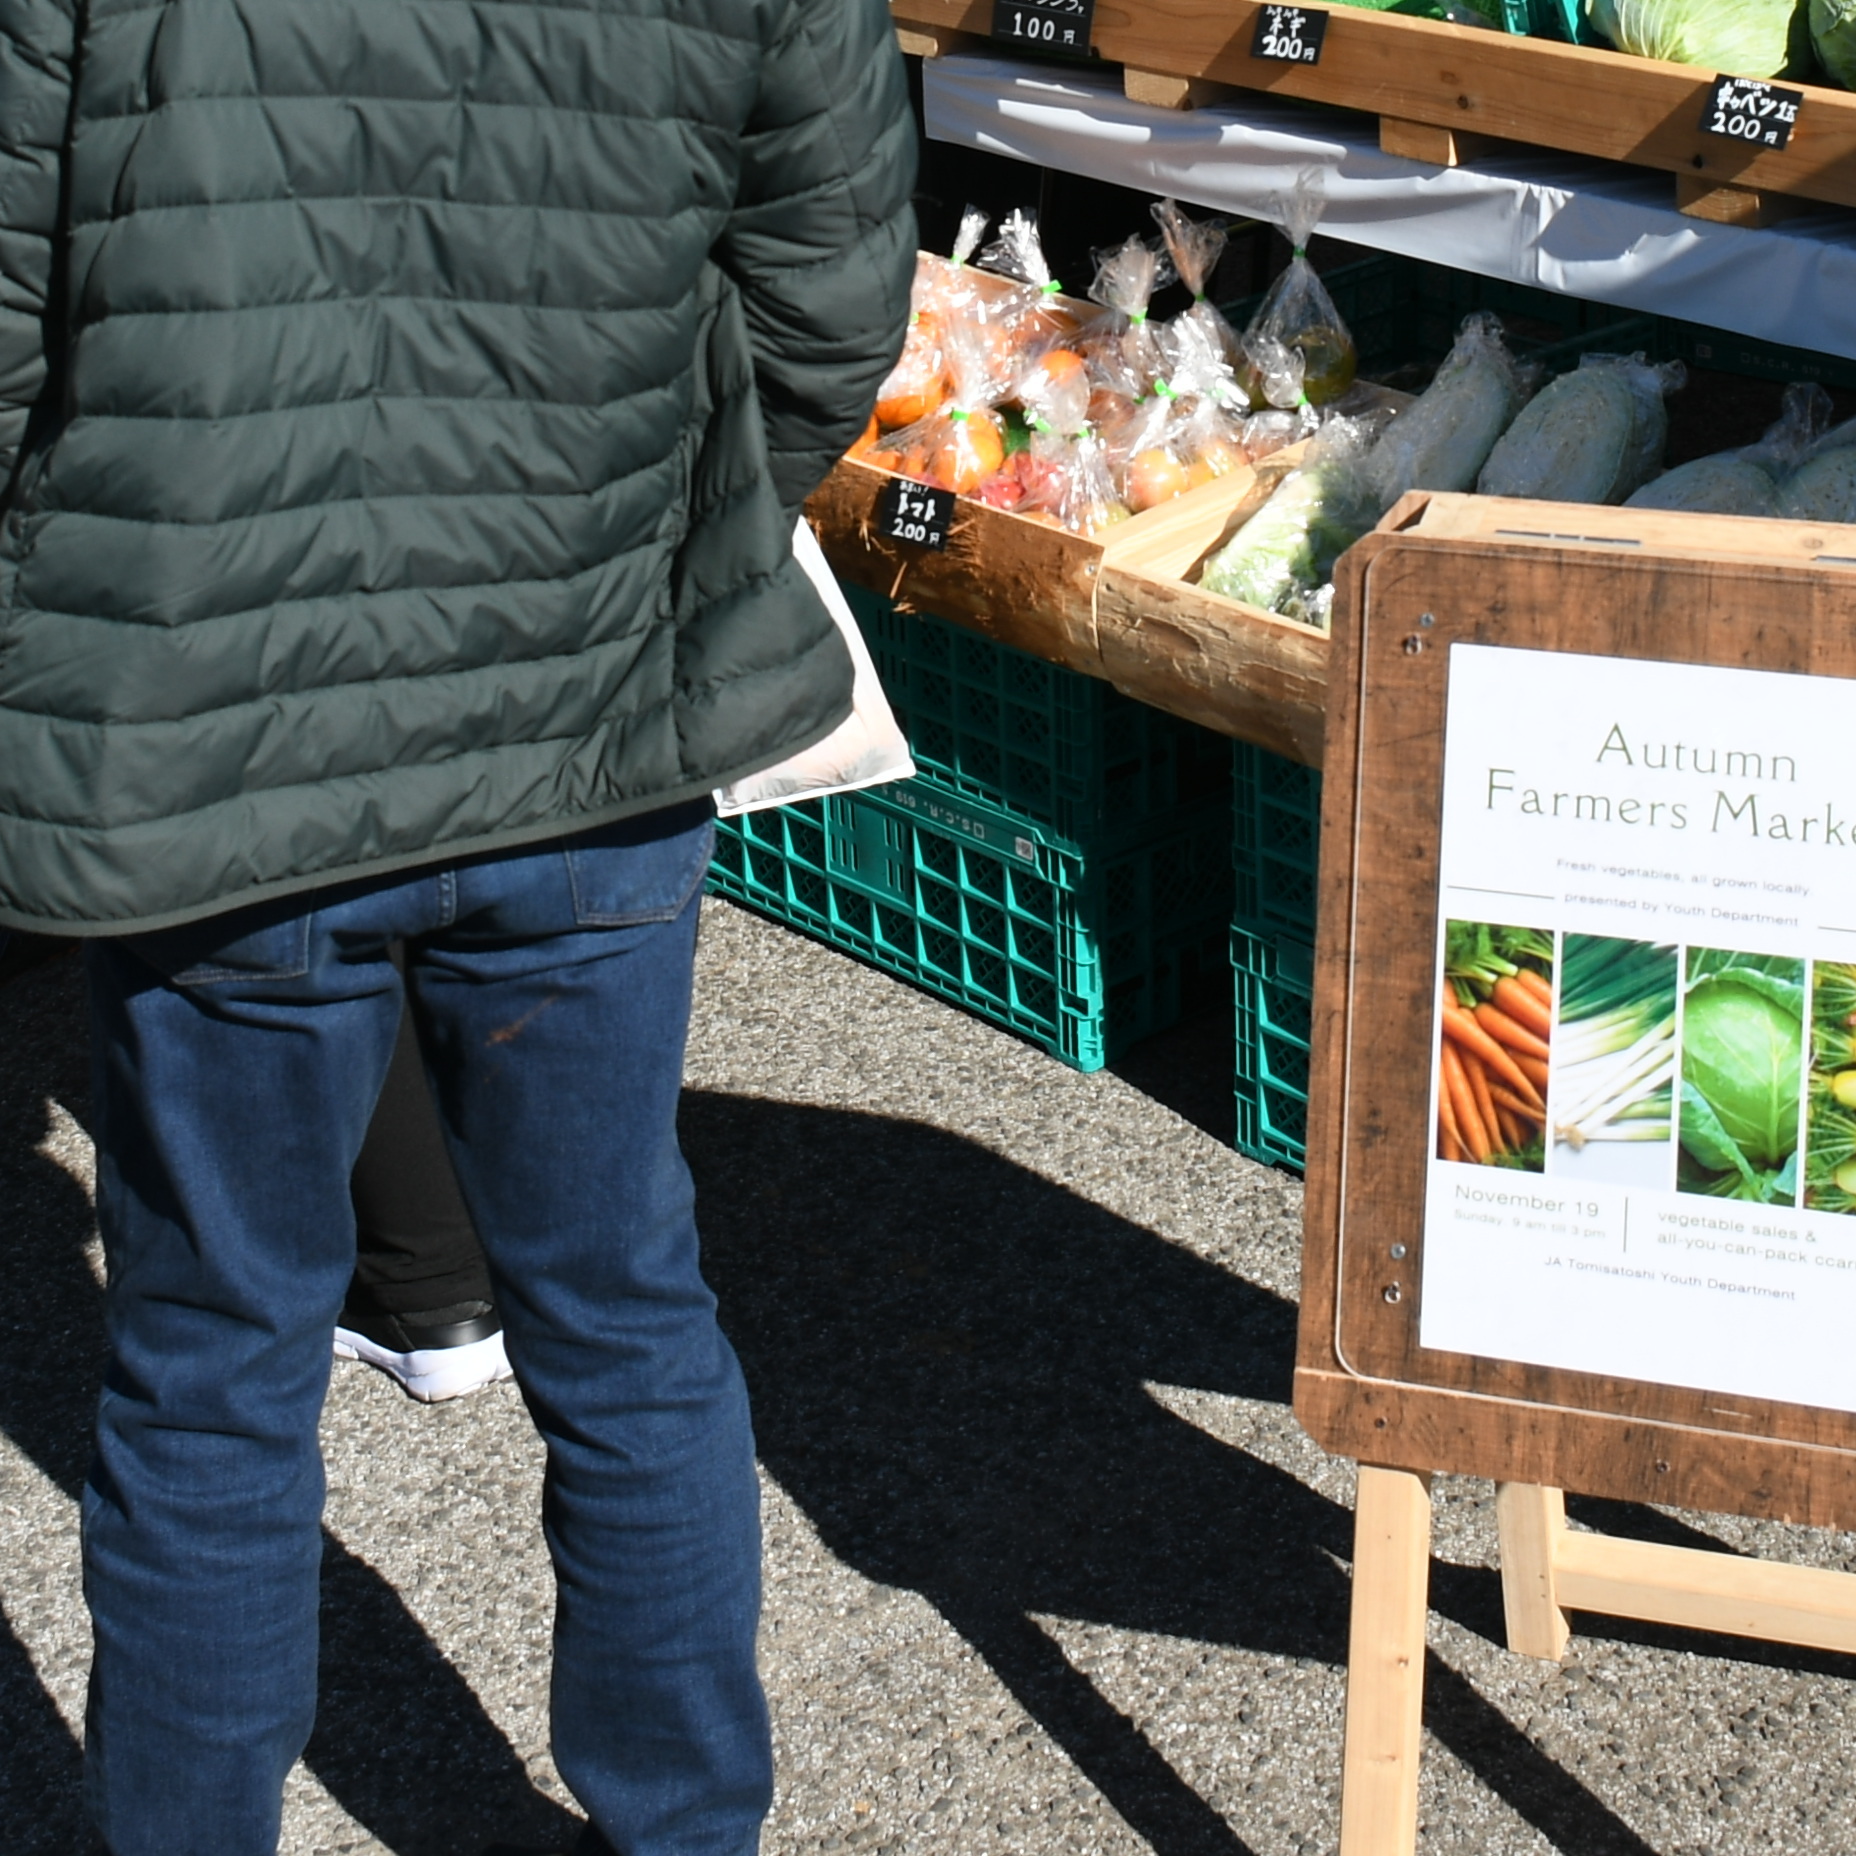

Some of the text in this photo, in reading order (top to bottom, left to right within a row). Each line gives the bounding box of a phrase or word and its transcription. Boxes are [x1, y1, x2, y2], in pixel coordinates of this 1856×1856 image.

[1012, 11, 1076, 45] 100円
[1269, 16, 1306, 38] ネギ
[1261, 34, 1316, 62] 200円
[1710, 111, 1778, 145] 200円
[896, 492, 936, 523] トマト
[891, 516, 941, 545] 200円
[1595, 722, 1797, 782] Autumn
[1485, 767, 1689, 830] Farmers
[1556, 858, 1597, 873] Fresh
[1601, 862, 1685, 884] vegetables,
[1690, 872, 1709, 885] all
[1712, 875, 1758, 892] grown
[1563, 891, 1800, 929] presented by Youth Department
[1454, 1183, 1600, 1218] November 19
[1512, 1216, 1521, 1227] 9
[1525, 1220, 1547, 1231] am
[1551, 1221, 1568, 1234] till
[1571, 1224, 1581, 1237] 3
[1583, 1227, 1607, 1242] pm
[1657, 1210, 1818, 1243] vegetable sales &
[1656, 1230, 1808, 1265] all-you-can-pack
[1543, 1255, 1796, 1302] JA Tomisatoshi Youth Department
